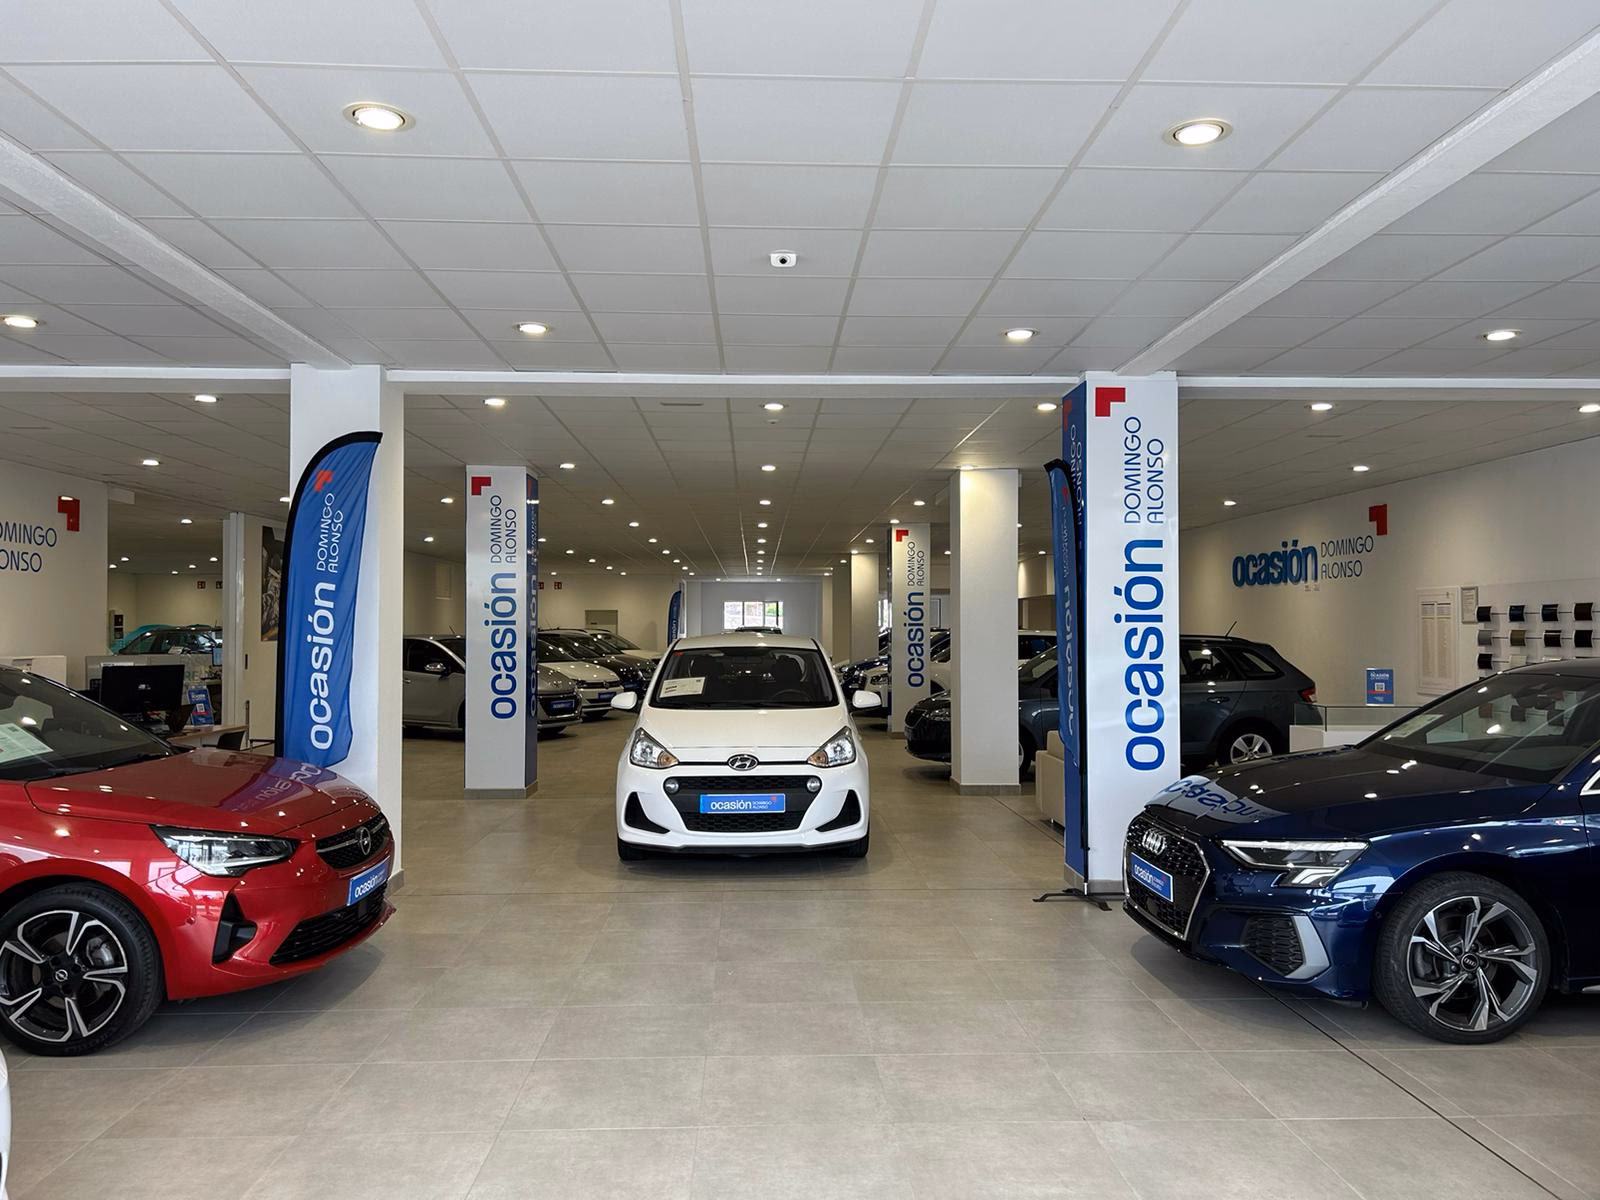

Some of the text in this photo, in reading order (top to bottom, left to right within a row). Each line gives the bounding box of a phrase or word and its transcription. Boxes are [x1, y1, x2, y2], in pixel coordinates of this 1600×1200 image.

[1124, 416, 1142, 524] DOMINGO
[1146, 438, 1164, 524] ALONSO
[0, 521, 57, 547] MINGO
[316, 493, 335, 571] DOMINGO
[328, 510, 344, 573] ALONSO
[490, 495, 502, 563] DOMINGO
[505, 509, 517, 563] ALONSO
[1232, 535, 1374, 587] ocasión DOMINGO
[907, 541, 916, 586] DOMINGO
[916, 550, 925, 586] ALONSO
[1321, 559, 1363, 579] ALONSO
[307, 581, 337, 750] ocasión
[484, 572, 517, 719] ocasión
[903, 591, 925, 688] ocasión
[1113, 539, 1165, 771] ocasión
[710, 799, 752, 810] ocasión
